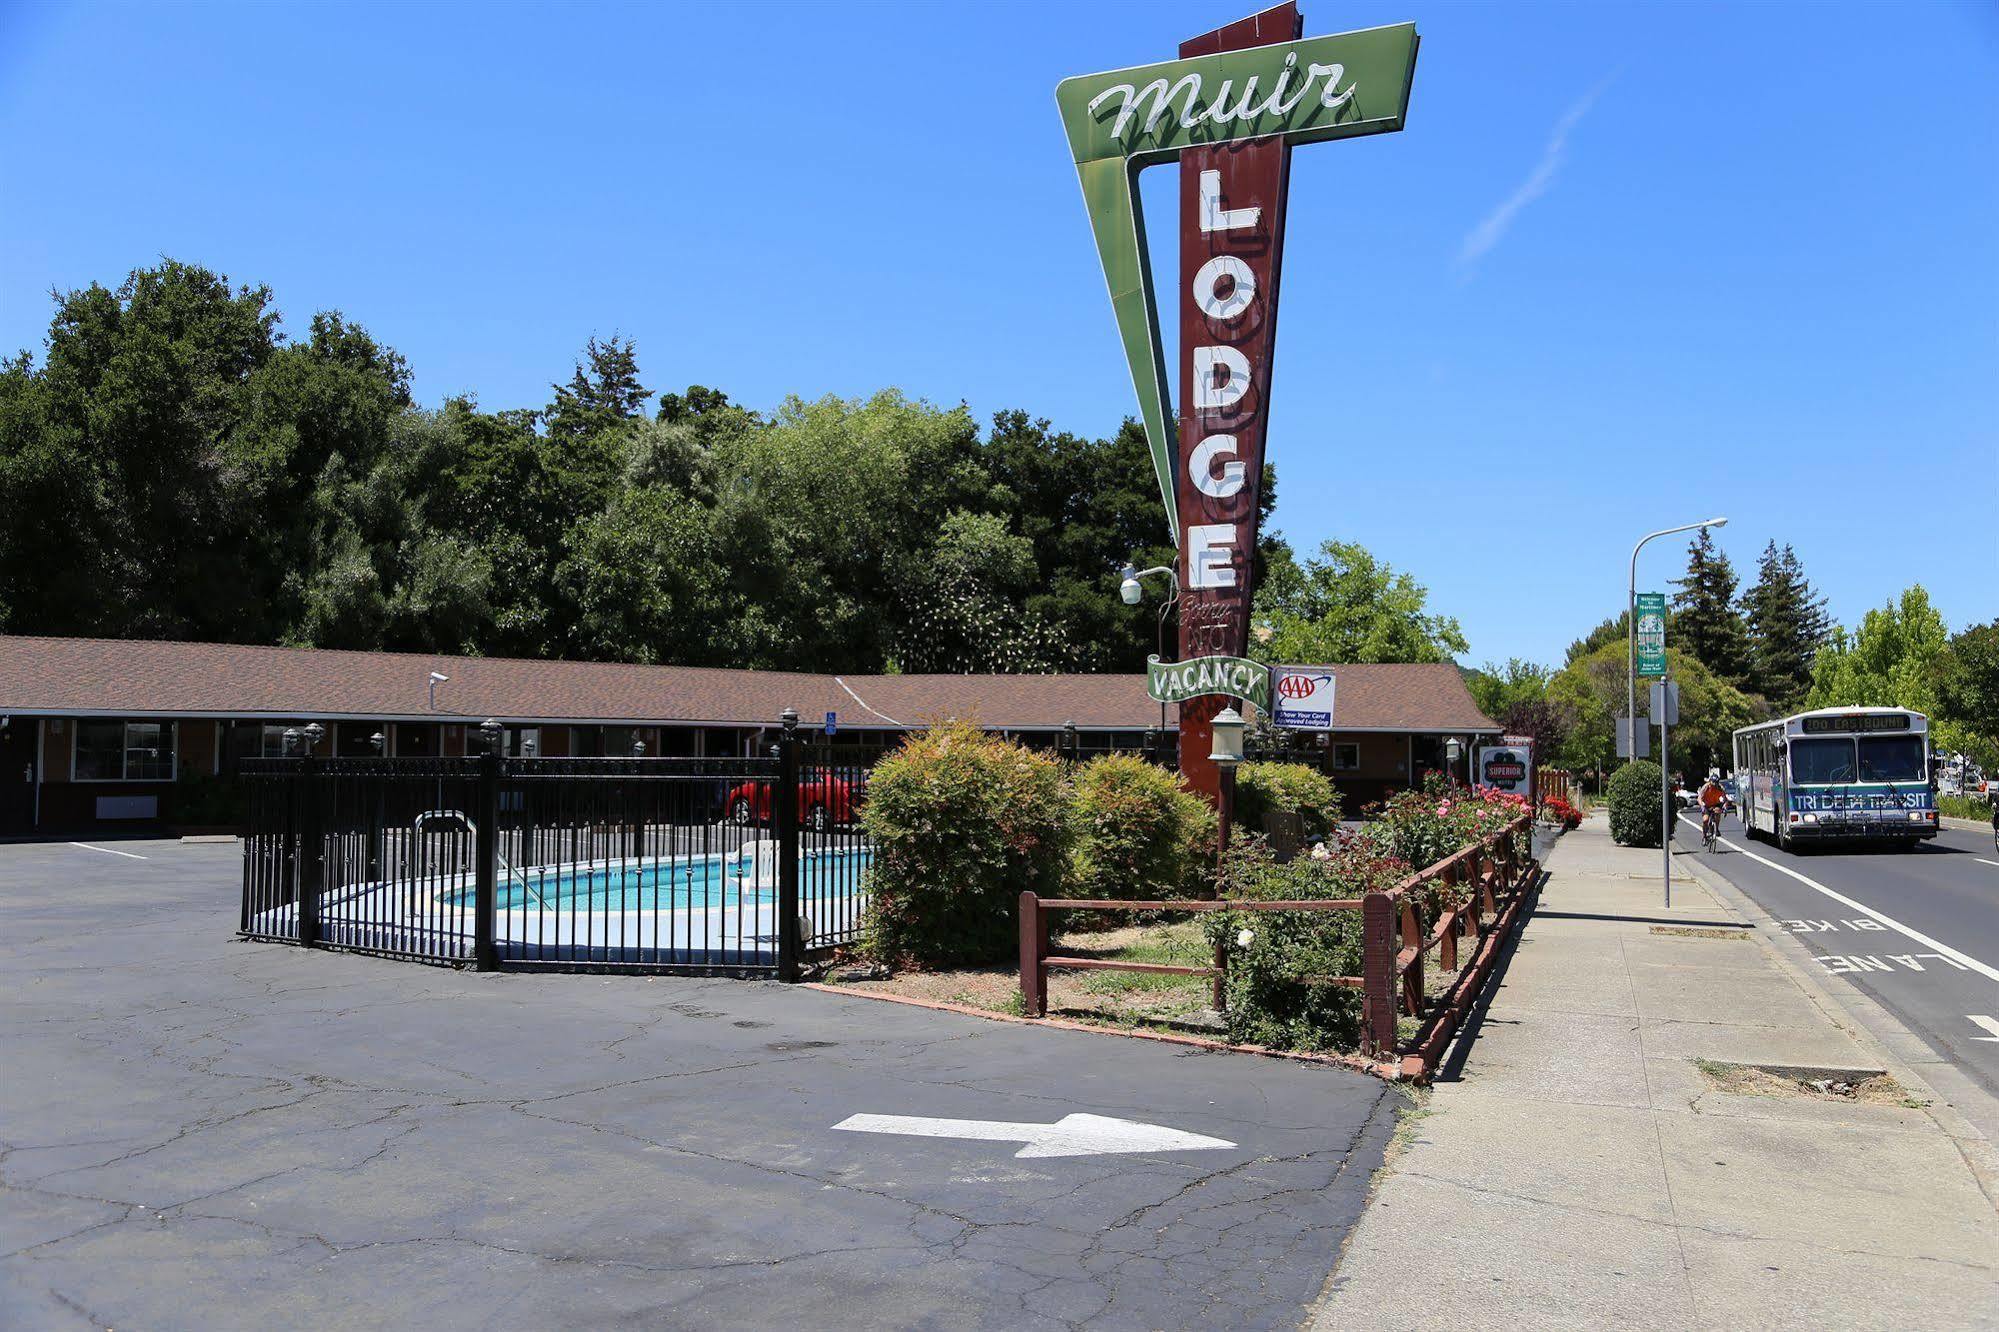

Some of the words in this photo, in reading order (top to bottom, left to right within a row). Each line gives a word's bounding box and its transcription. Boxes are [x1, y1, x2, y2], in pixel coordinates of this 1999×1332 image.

[1187, 169, 1262, 589] LODGE
[1152, 662, 1263, 697] VACANCY
[1282, 676, 1311, 698] AAA
[1305, 719, 1329, 727] Lodging
[1489, 767, 1521, 776] SUPERIOR
[1795, 795, 1817, 810] TRI
[1822, 794, 1863, 809] DELTA
[1867, 792, 1927, 809] TRANSIT
[1773, 919, 1888, 935] BIKE
[1811, 953, 1969, 975] LANE
